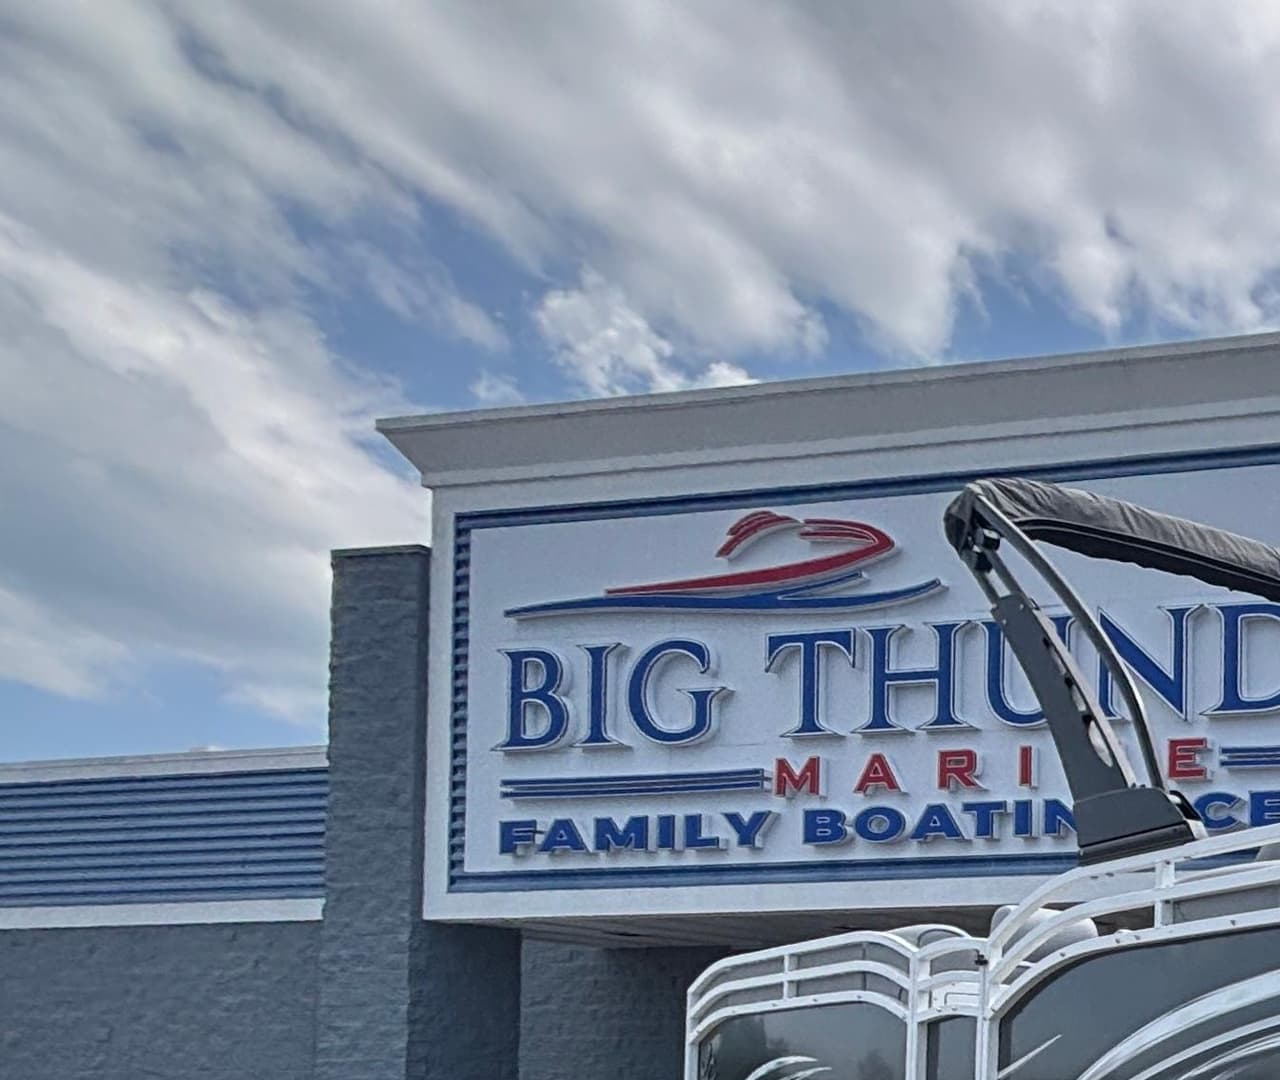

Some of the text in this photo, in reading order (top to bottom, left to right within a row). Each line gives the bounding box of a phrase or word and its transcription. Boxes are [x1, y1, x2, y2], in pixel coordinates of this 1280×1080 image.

[491, 638, 734, 751] BIG
[775, 736, 1208, 798] MARIE
[499, 810, 774, 856] FAMILY
[802, 800, 1077, 846] BOATIN
